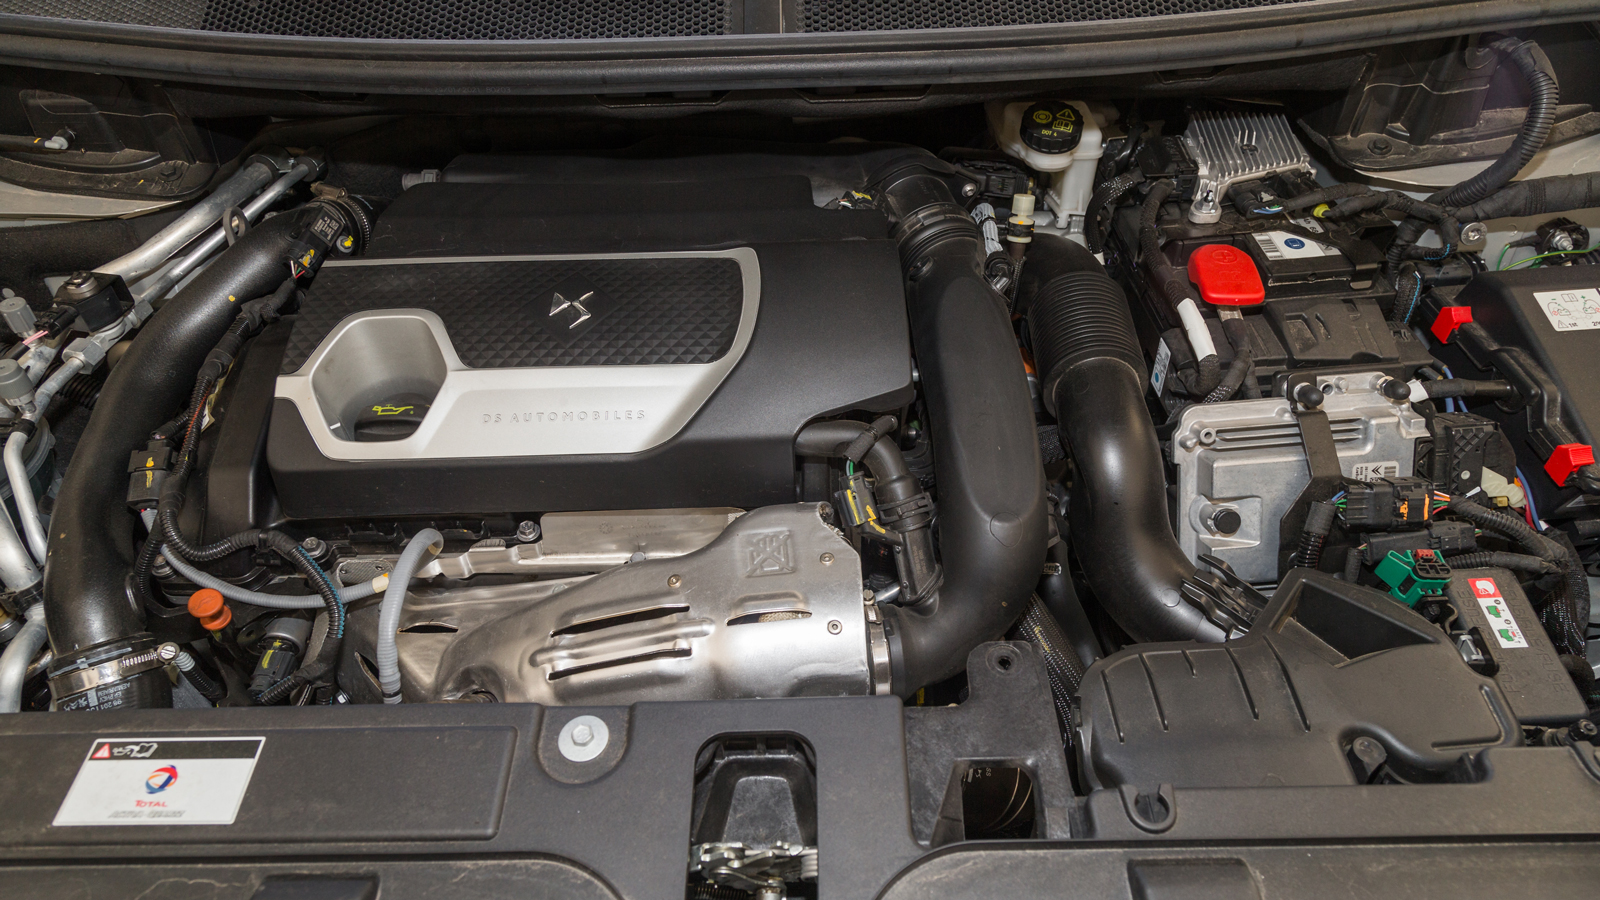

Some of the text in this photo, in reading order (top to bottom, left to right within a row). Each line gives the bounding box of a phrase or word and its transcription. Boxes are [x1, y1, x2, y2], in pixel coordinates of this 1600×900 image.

[481, 410, 646, 424] DS AUTOMOBILES
[135, 799, 168, 808] TOTAL
